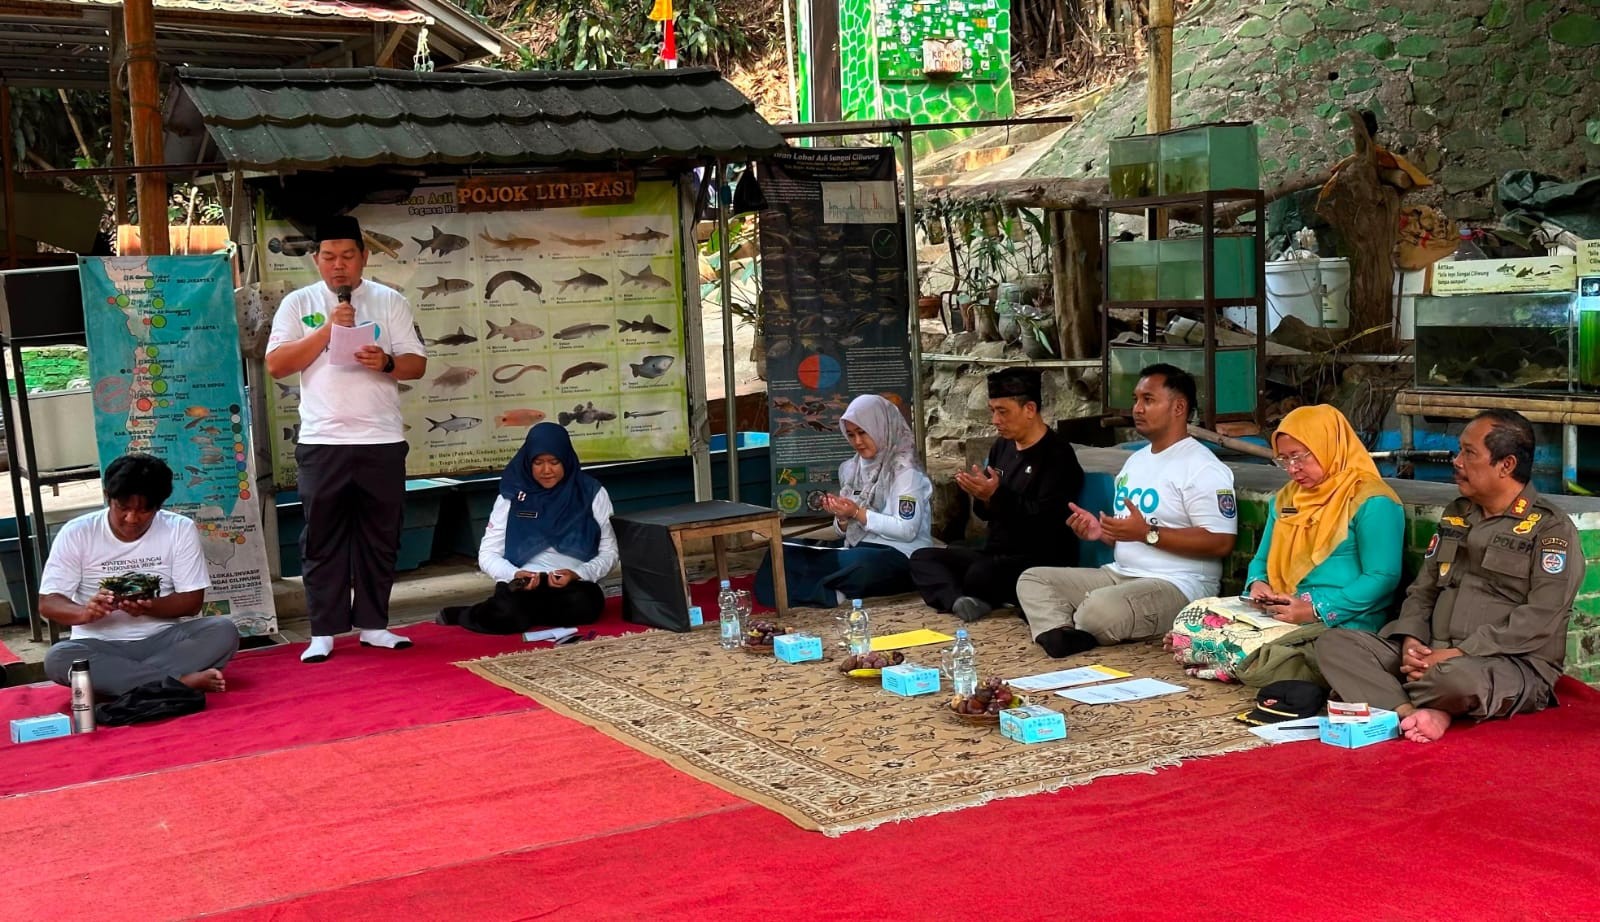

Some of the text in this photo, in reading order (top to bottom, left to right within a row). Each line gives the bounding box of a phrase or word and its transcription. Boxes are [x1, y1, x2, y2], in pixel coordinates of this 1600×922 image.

[459, 180, 634, 204] POJOK LITERASI
[1114, 486, 1160, 513] eco
[107, 563, 140, 572] INDONESIA
